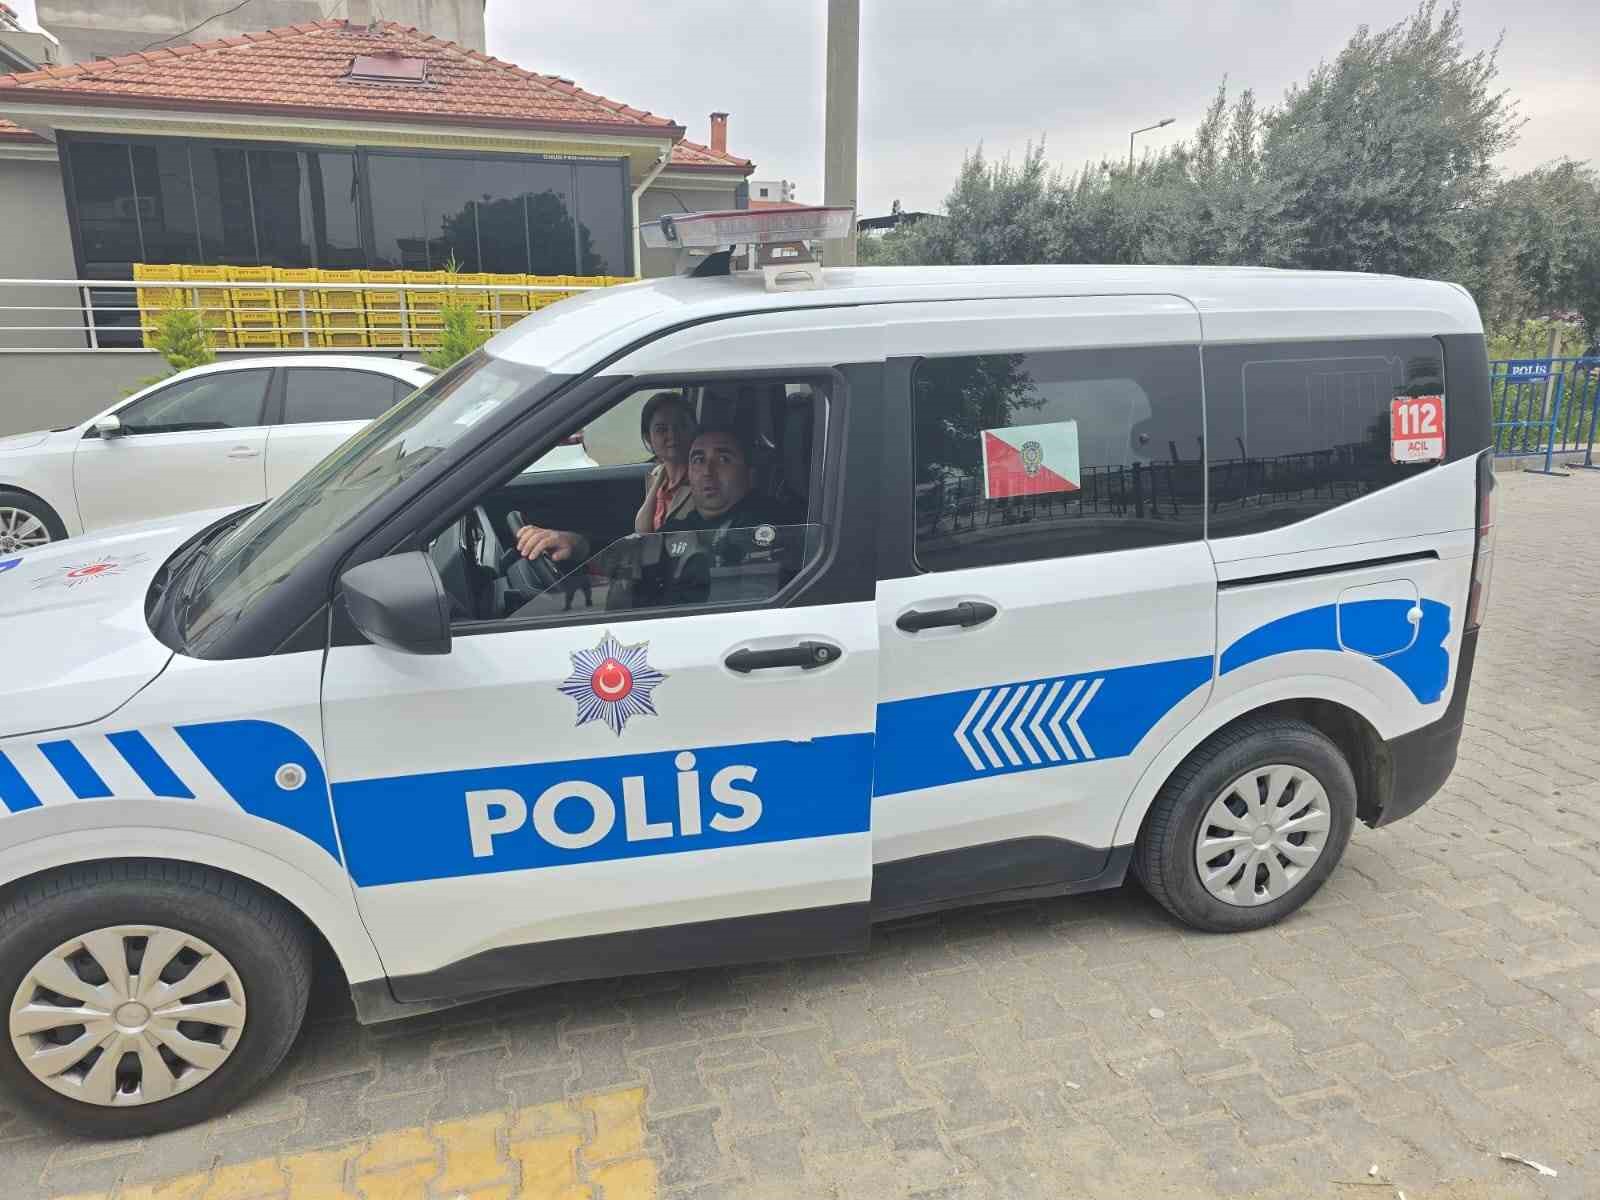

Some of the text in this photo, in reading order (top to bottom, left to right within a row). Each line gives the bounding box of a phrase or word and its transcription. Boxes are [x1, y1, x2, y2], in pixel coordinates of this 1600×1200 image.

[1511, 363, 1547, 376] POLİS
[1398, 403, 1438, 435] 112
[464, 750, 764, 858] POLİS
